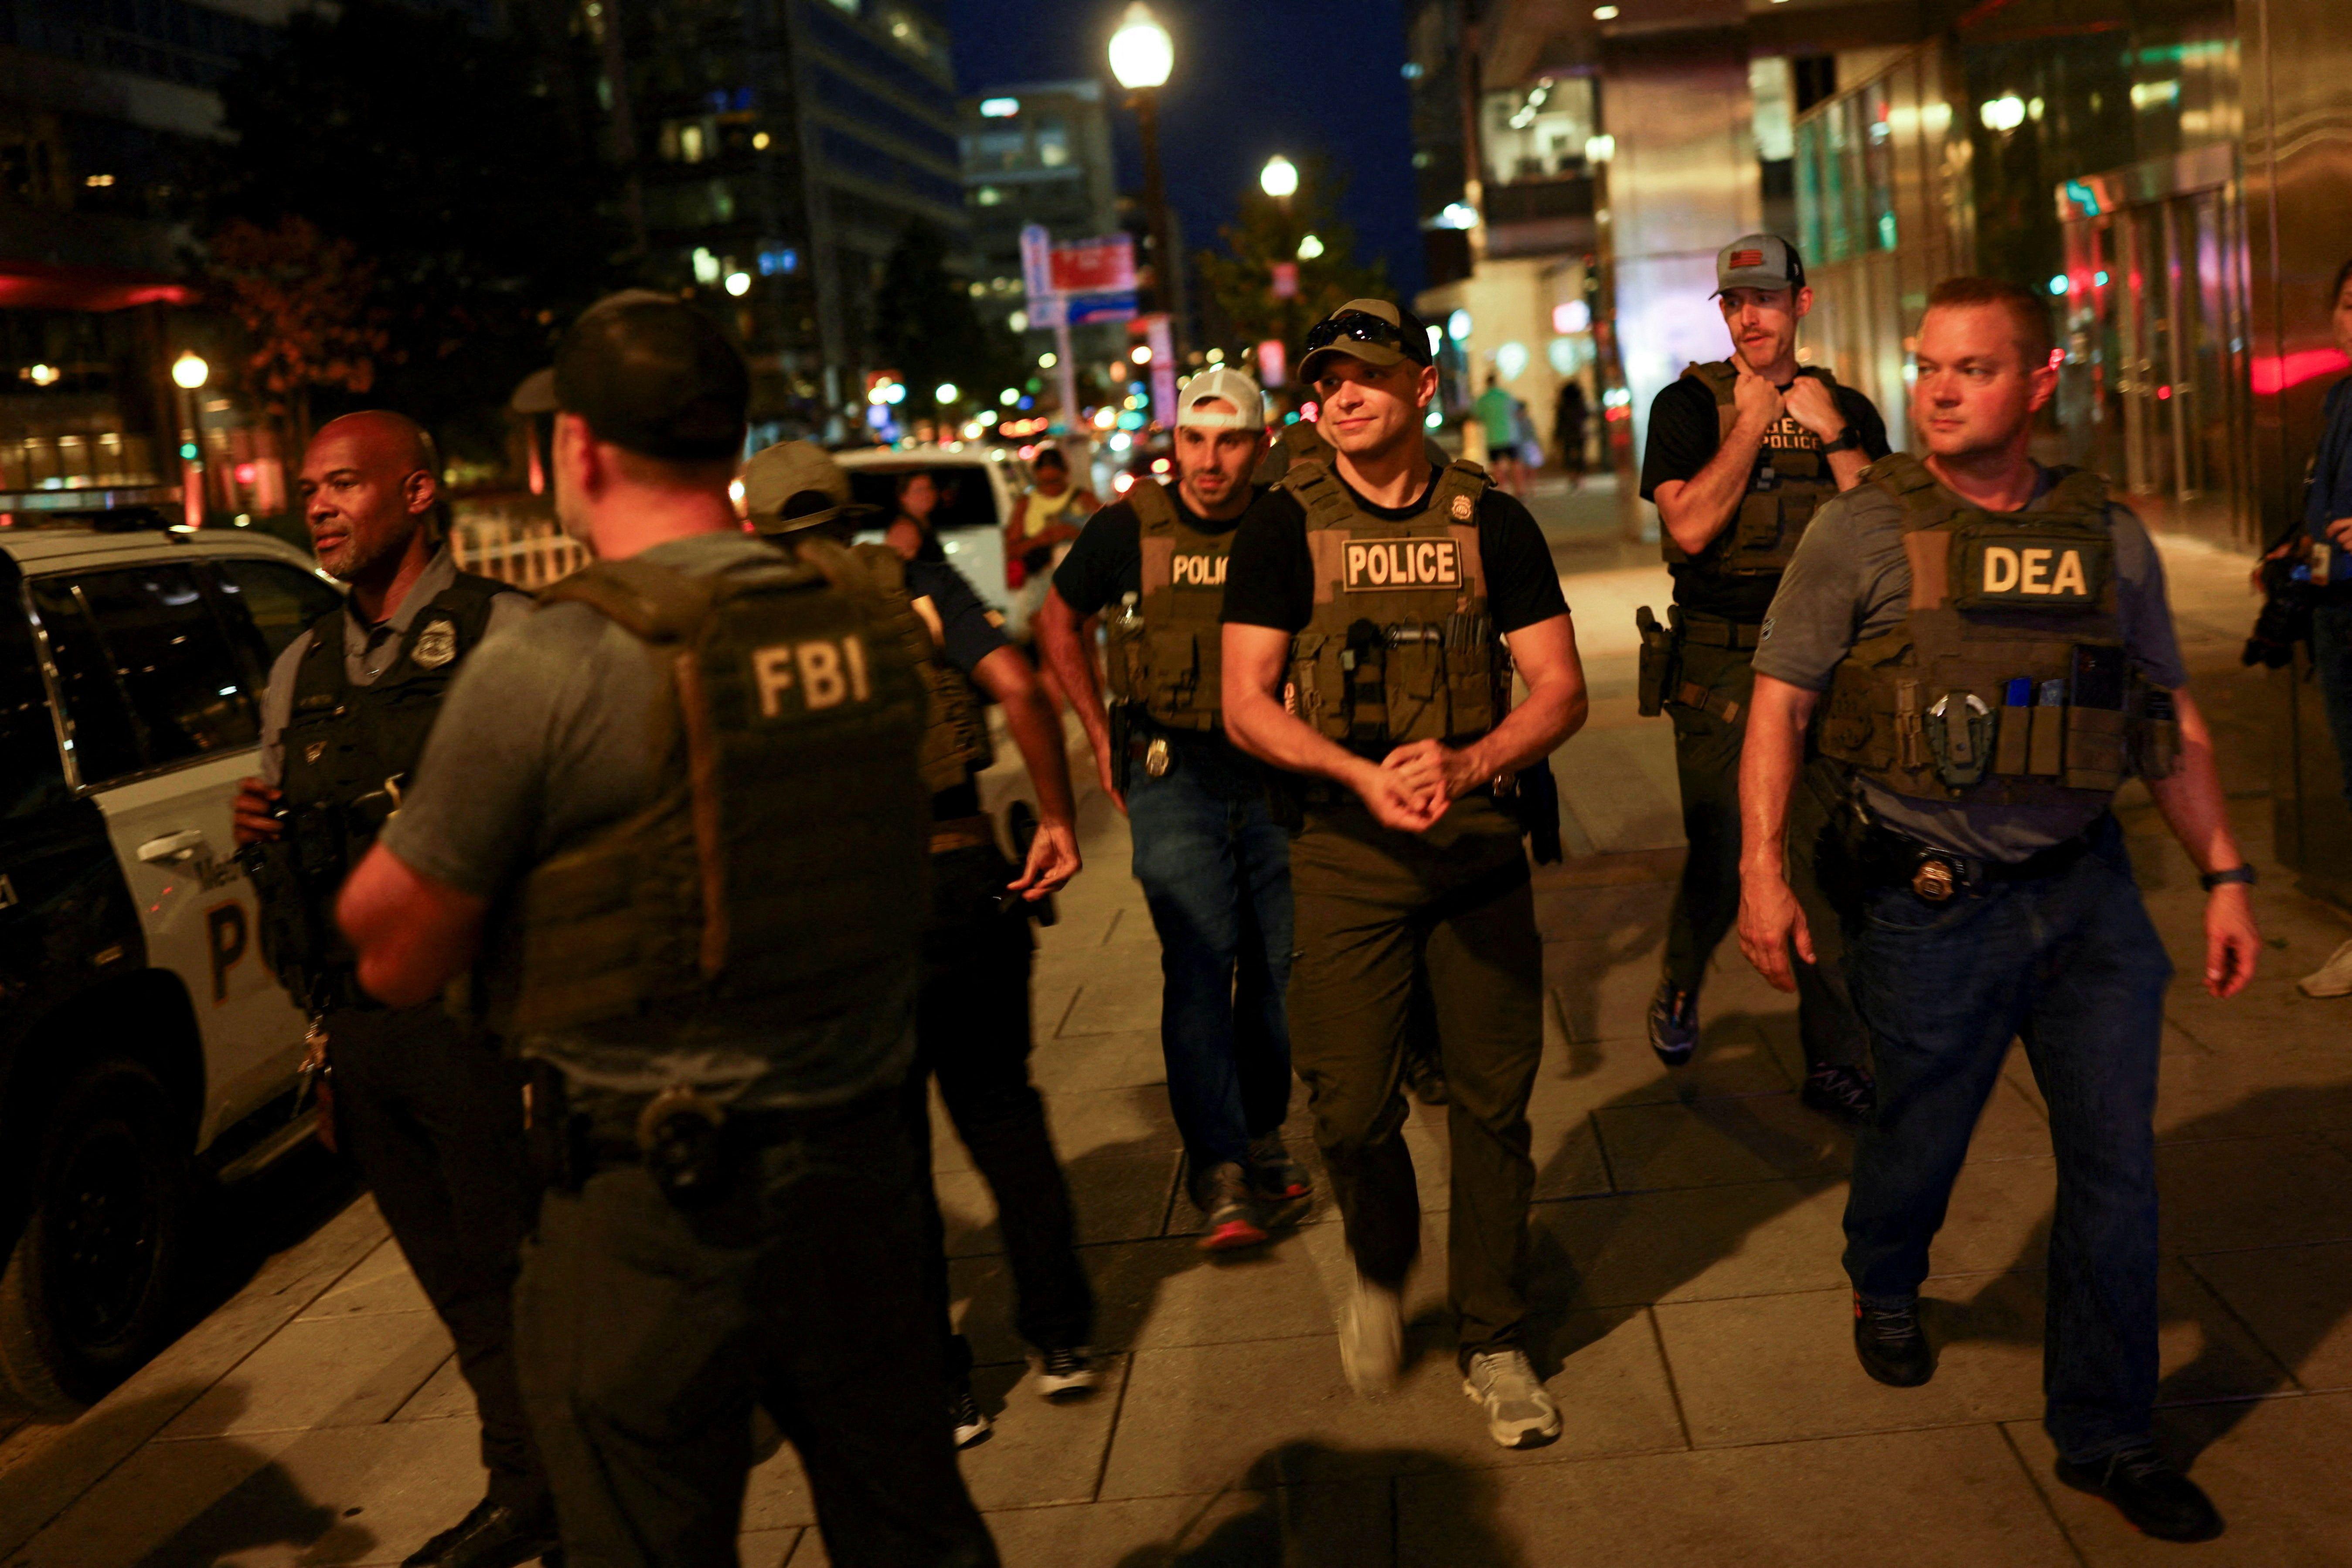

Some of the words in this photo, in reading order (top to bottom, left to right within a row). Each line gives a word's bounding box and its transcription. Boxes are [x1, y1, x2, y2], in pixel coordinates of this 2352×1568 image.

[1348, 543, 1455, 585] POLICE
[1984, 547, 2087, 595] DEA
[752, 636, 868, 716] FBI
